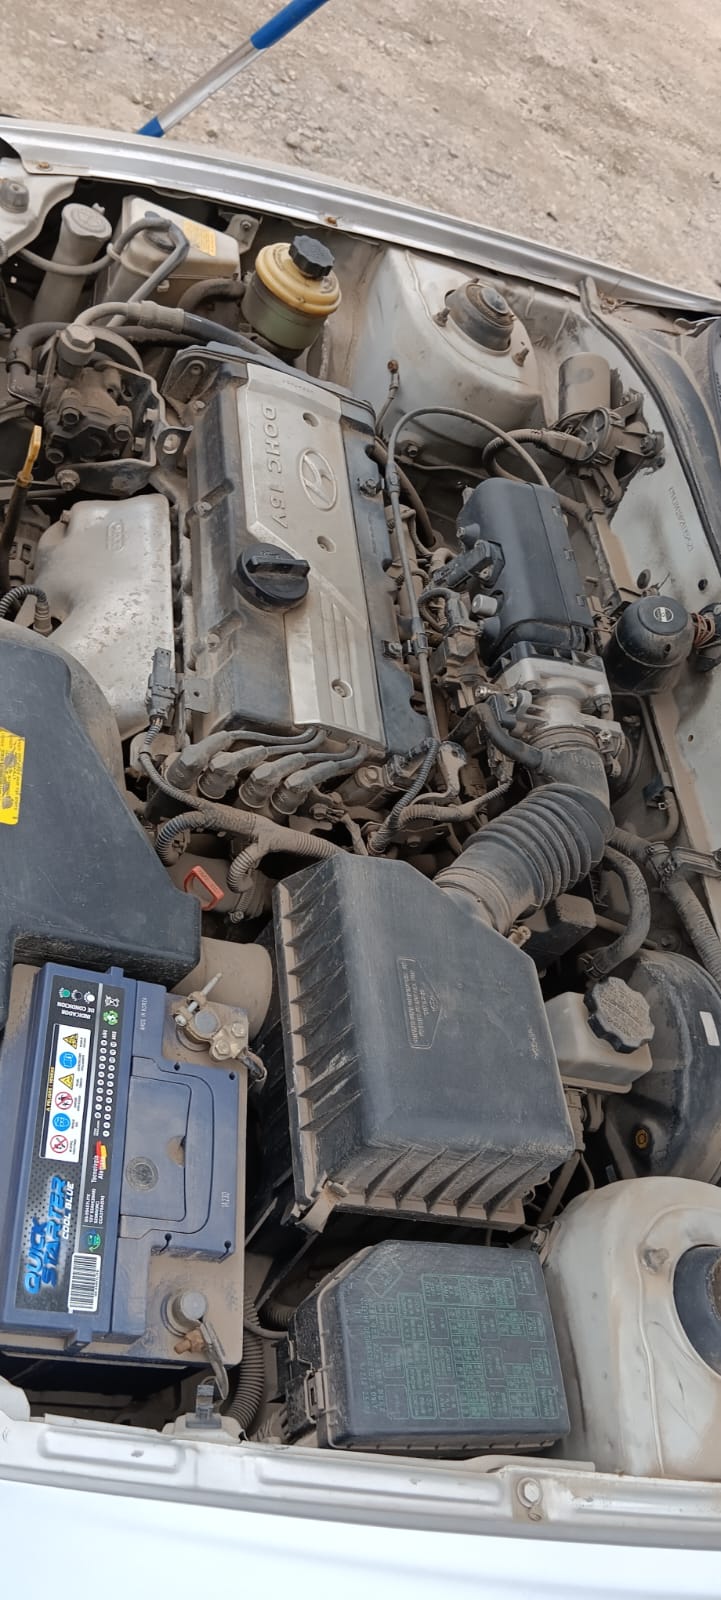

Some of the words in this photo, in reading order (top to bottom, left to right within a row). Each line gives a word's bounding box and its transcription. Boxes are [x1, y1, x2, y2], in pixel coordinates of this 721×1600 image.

[262, 404, 282, 474] DOHC
[270, 487, 288, 529] 16V
[64, 1181, 75, 1211] BLUE
[41, 1175, 67, 1287] STARTER
[62, 1213, 72, 1240] COOL
[23, 1216, 47, 1295] QUICK
